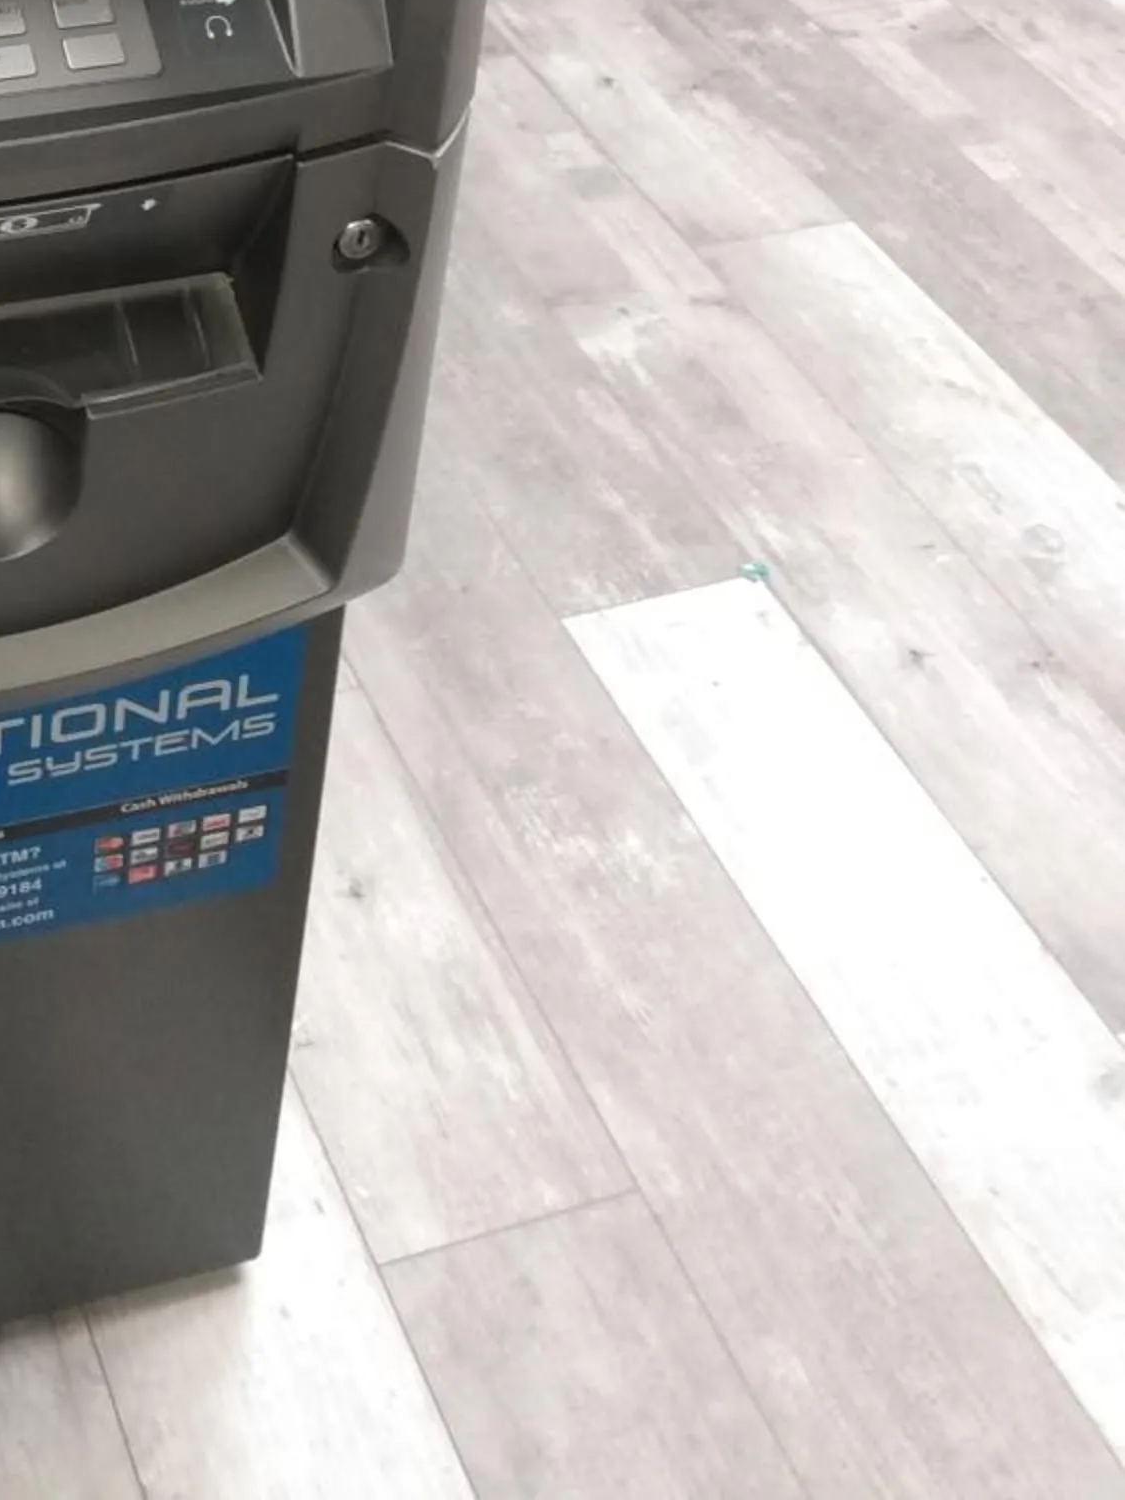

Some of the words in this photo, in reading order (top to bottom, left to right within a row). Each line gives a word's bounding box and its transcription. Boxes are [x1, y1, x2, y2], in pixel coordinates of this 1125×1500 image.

[6, 712, 277, 787] SYSTEMS
[120, 799, 156, 813] Cash
[159, 779, 249, 805] Withdrawals
